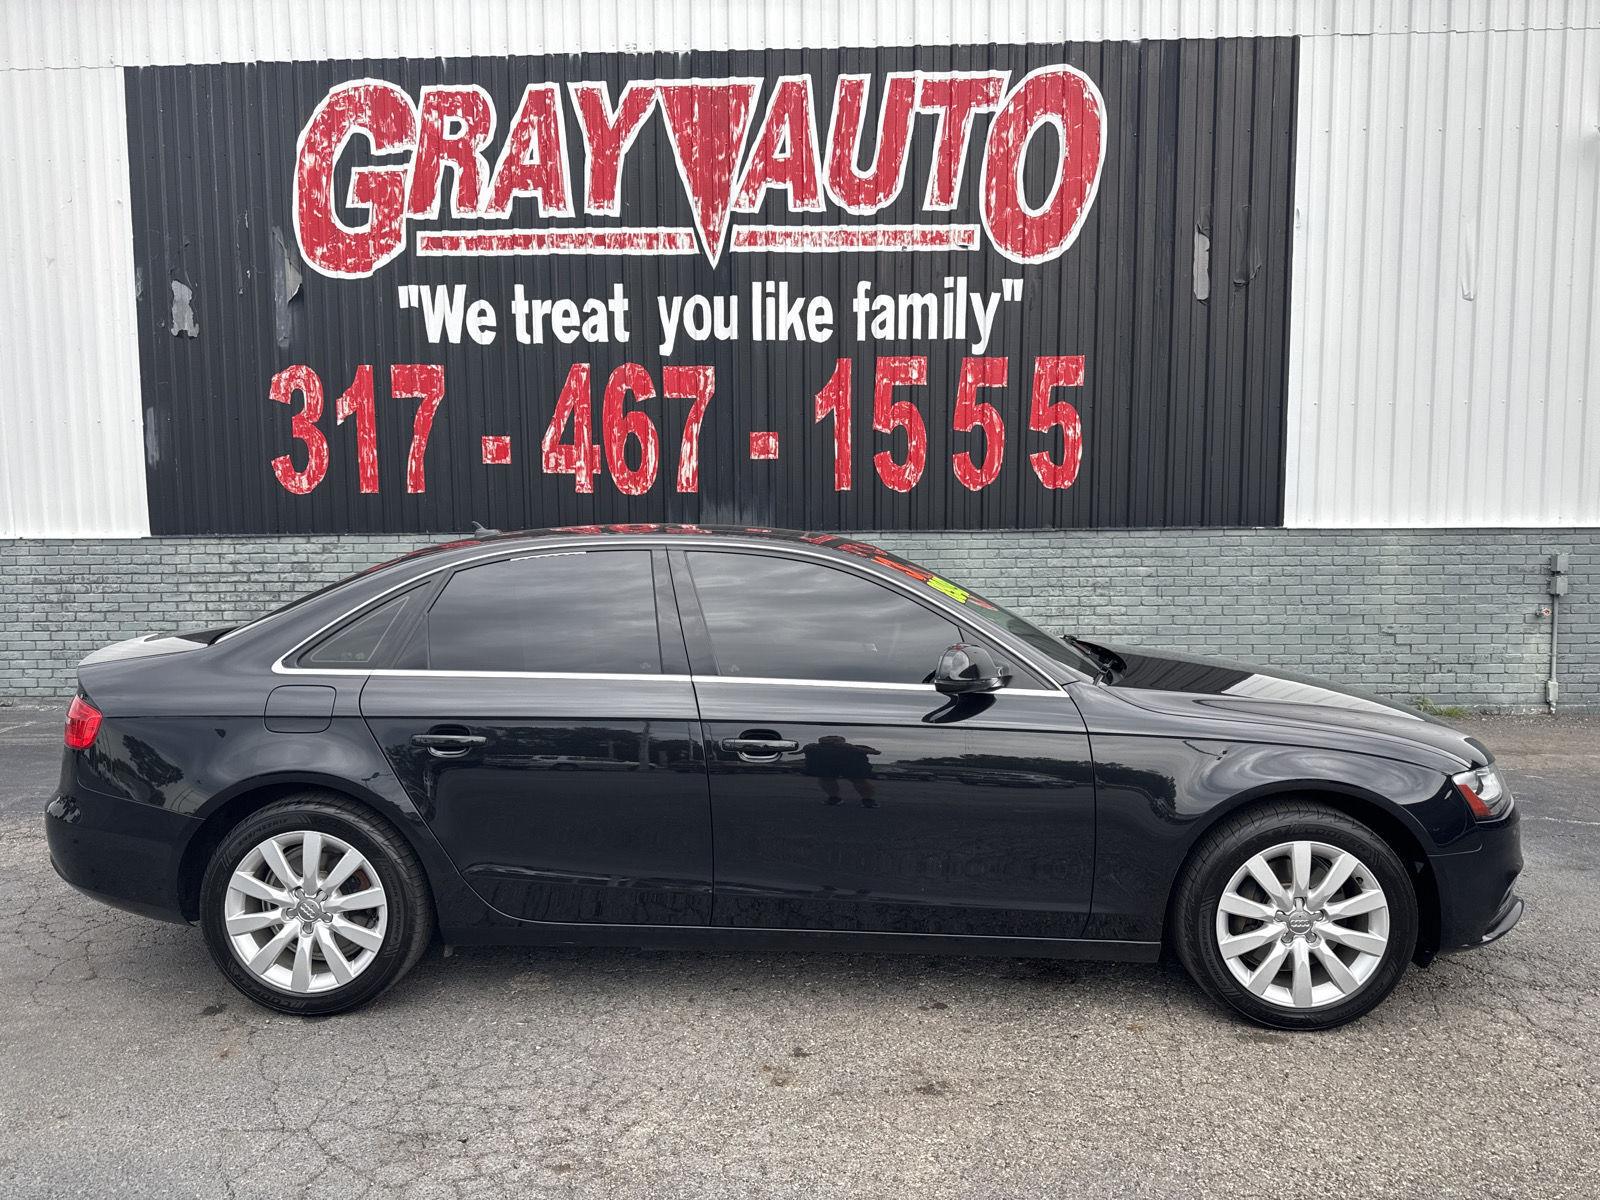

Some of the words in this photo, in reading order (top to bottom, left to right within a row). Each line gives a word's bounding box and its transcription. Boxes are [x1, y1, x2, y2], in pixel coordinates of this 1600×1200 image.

[398, 284, 496, 345] "We
[512, 283, 630, 344] treat
[657, 294, 738, 356] you
[752, 280, 834, 343] like
[853, 276, 1023, 356] family"
[269, 363, 445, 495] 317
[542, 362, 715, 495] 467
